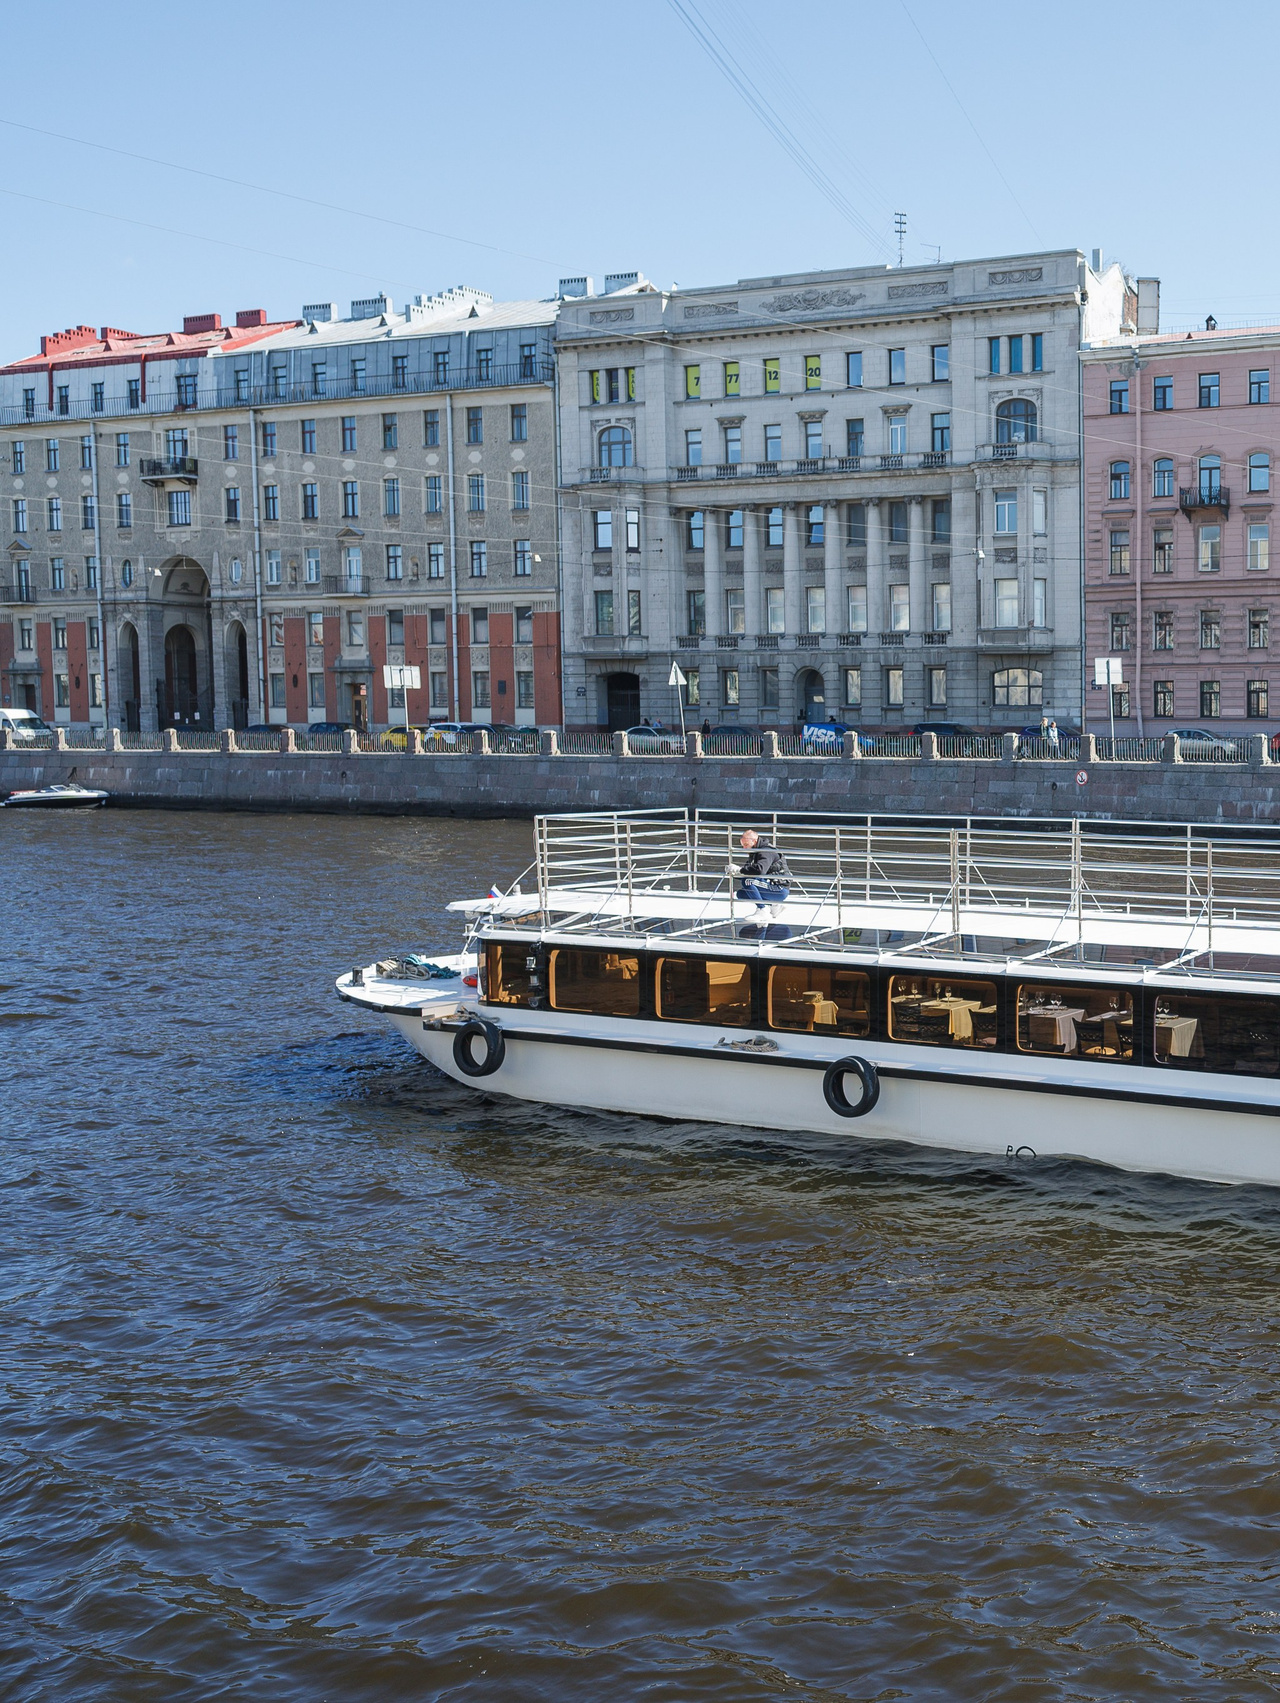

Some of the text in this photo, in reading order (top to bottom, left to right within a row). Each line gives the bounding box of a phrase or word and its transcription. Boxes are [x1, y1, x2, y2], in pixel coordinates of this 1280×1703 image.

[694, 367, 821, 386] 7 77 12 20
